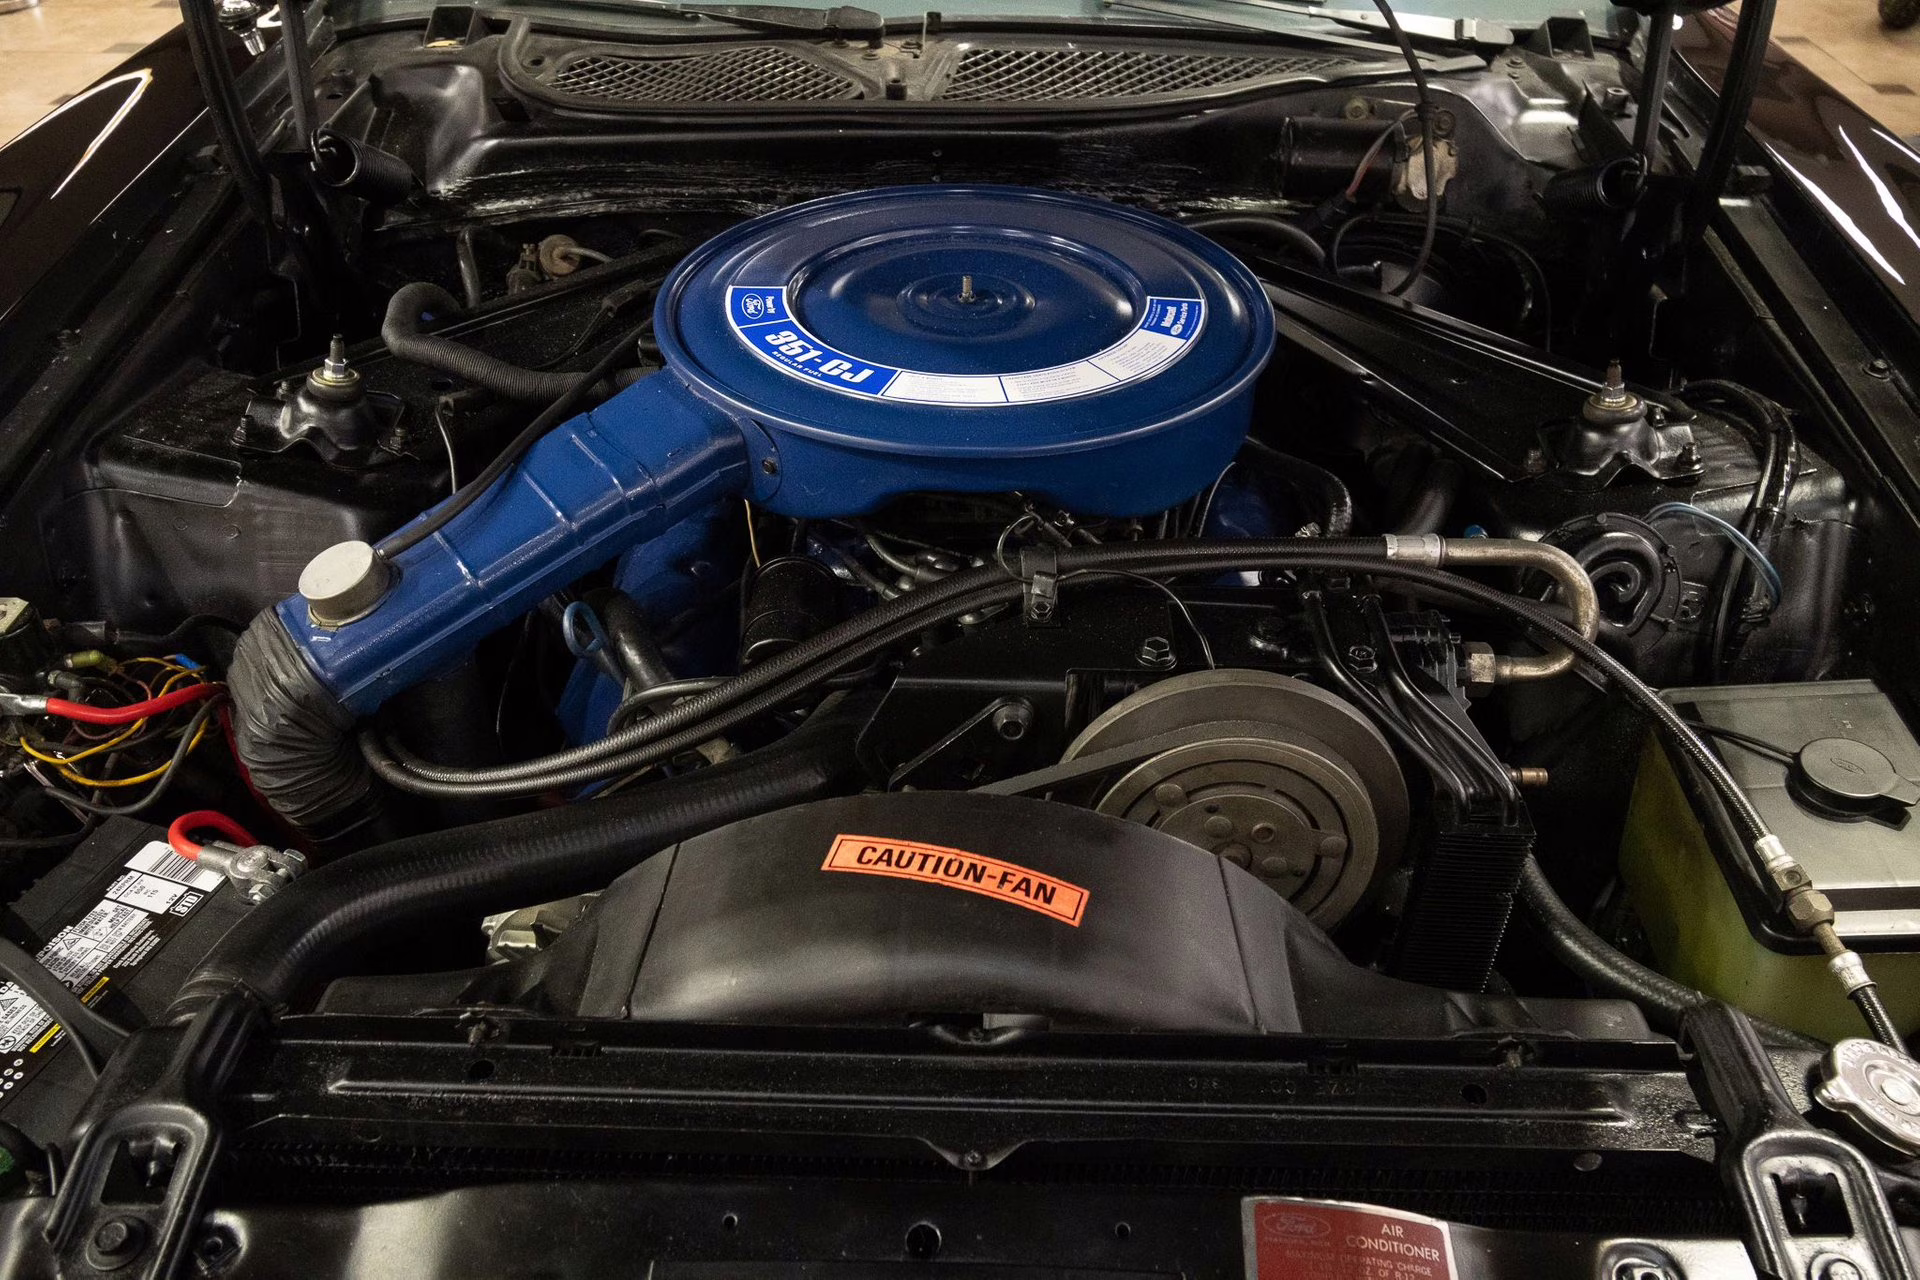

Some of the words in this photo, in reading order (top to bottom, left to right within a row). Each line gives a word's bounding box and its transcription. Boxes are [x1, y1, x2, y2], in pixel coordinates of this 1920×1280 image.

[765, 331, 874, 383] 351-CJ
[772, 351, 803, 369] REGULAR
[803, 367, 823, 377] FUEL
[856, 846, 1056, 905] CAUTION-FAN
[173, 894, 199, 913] STD
[1381, 1223, 1404, 1238] AIR
[1346, 1235, 1440, 1262] CONDITIONER
[1397, 1261, 1432, 1277] CHARGE
